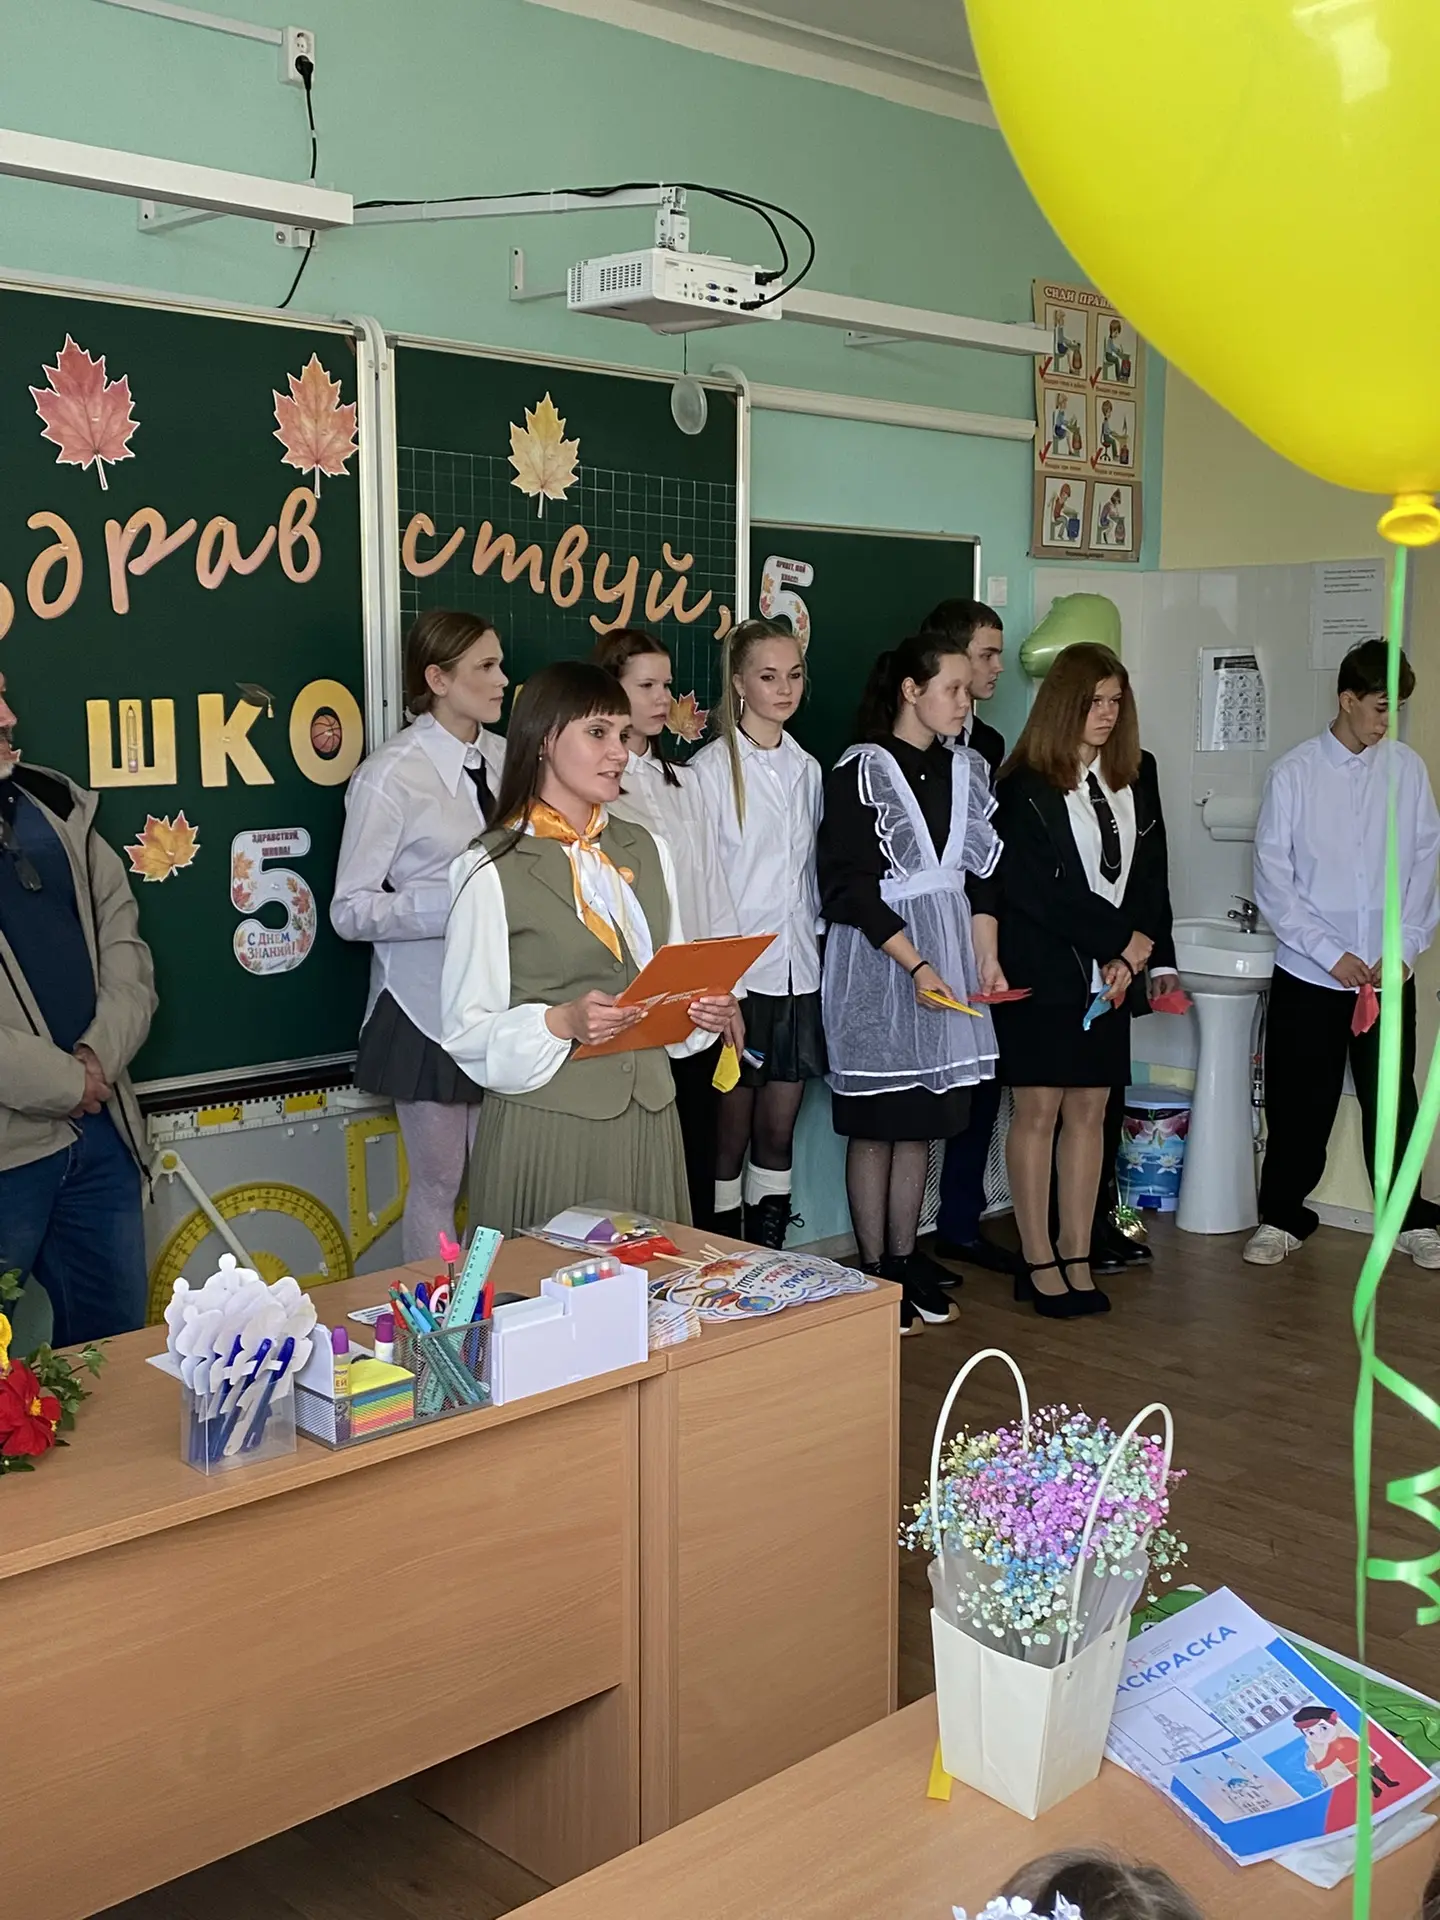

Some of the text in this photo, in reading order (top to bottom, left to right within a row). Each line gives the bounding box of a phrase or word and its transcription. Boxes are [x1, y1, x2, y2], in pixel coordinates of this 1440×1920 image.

[1044, 286, 1115, 311] СИДИ ПРАВИ
[86, 679, 363, 788] ШКО
[247, 932, 256, 946] С
[247, 941, 296, 960] ЗНАНИЙ!
[188, 1094, 323, 1127] 1 2 3 4
[1116, 1626, 1238, 1696] АСКРАСКА
